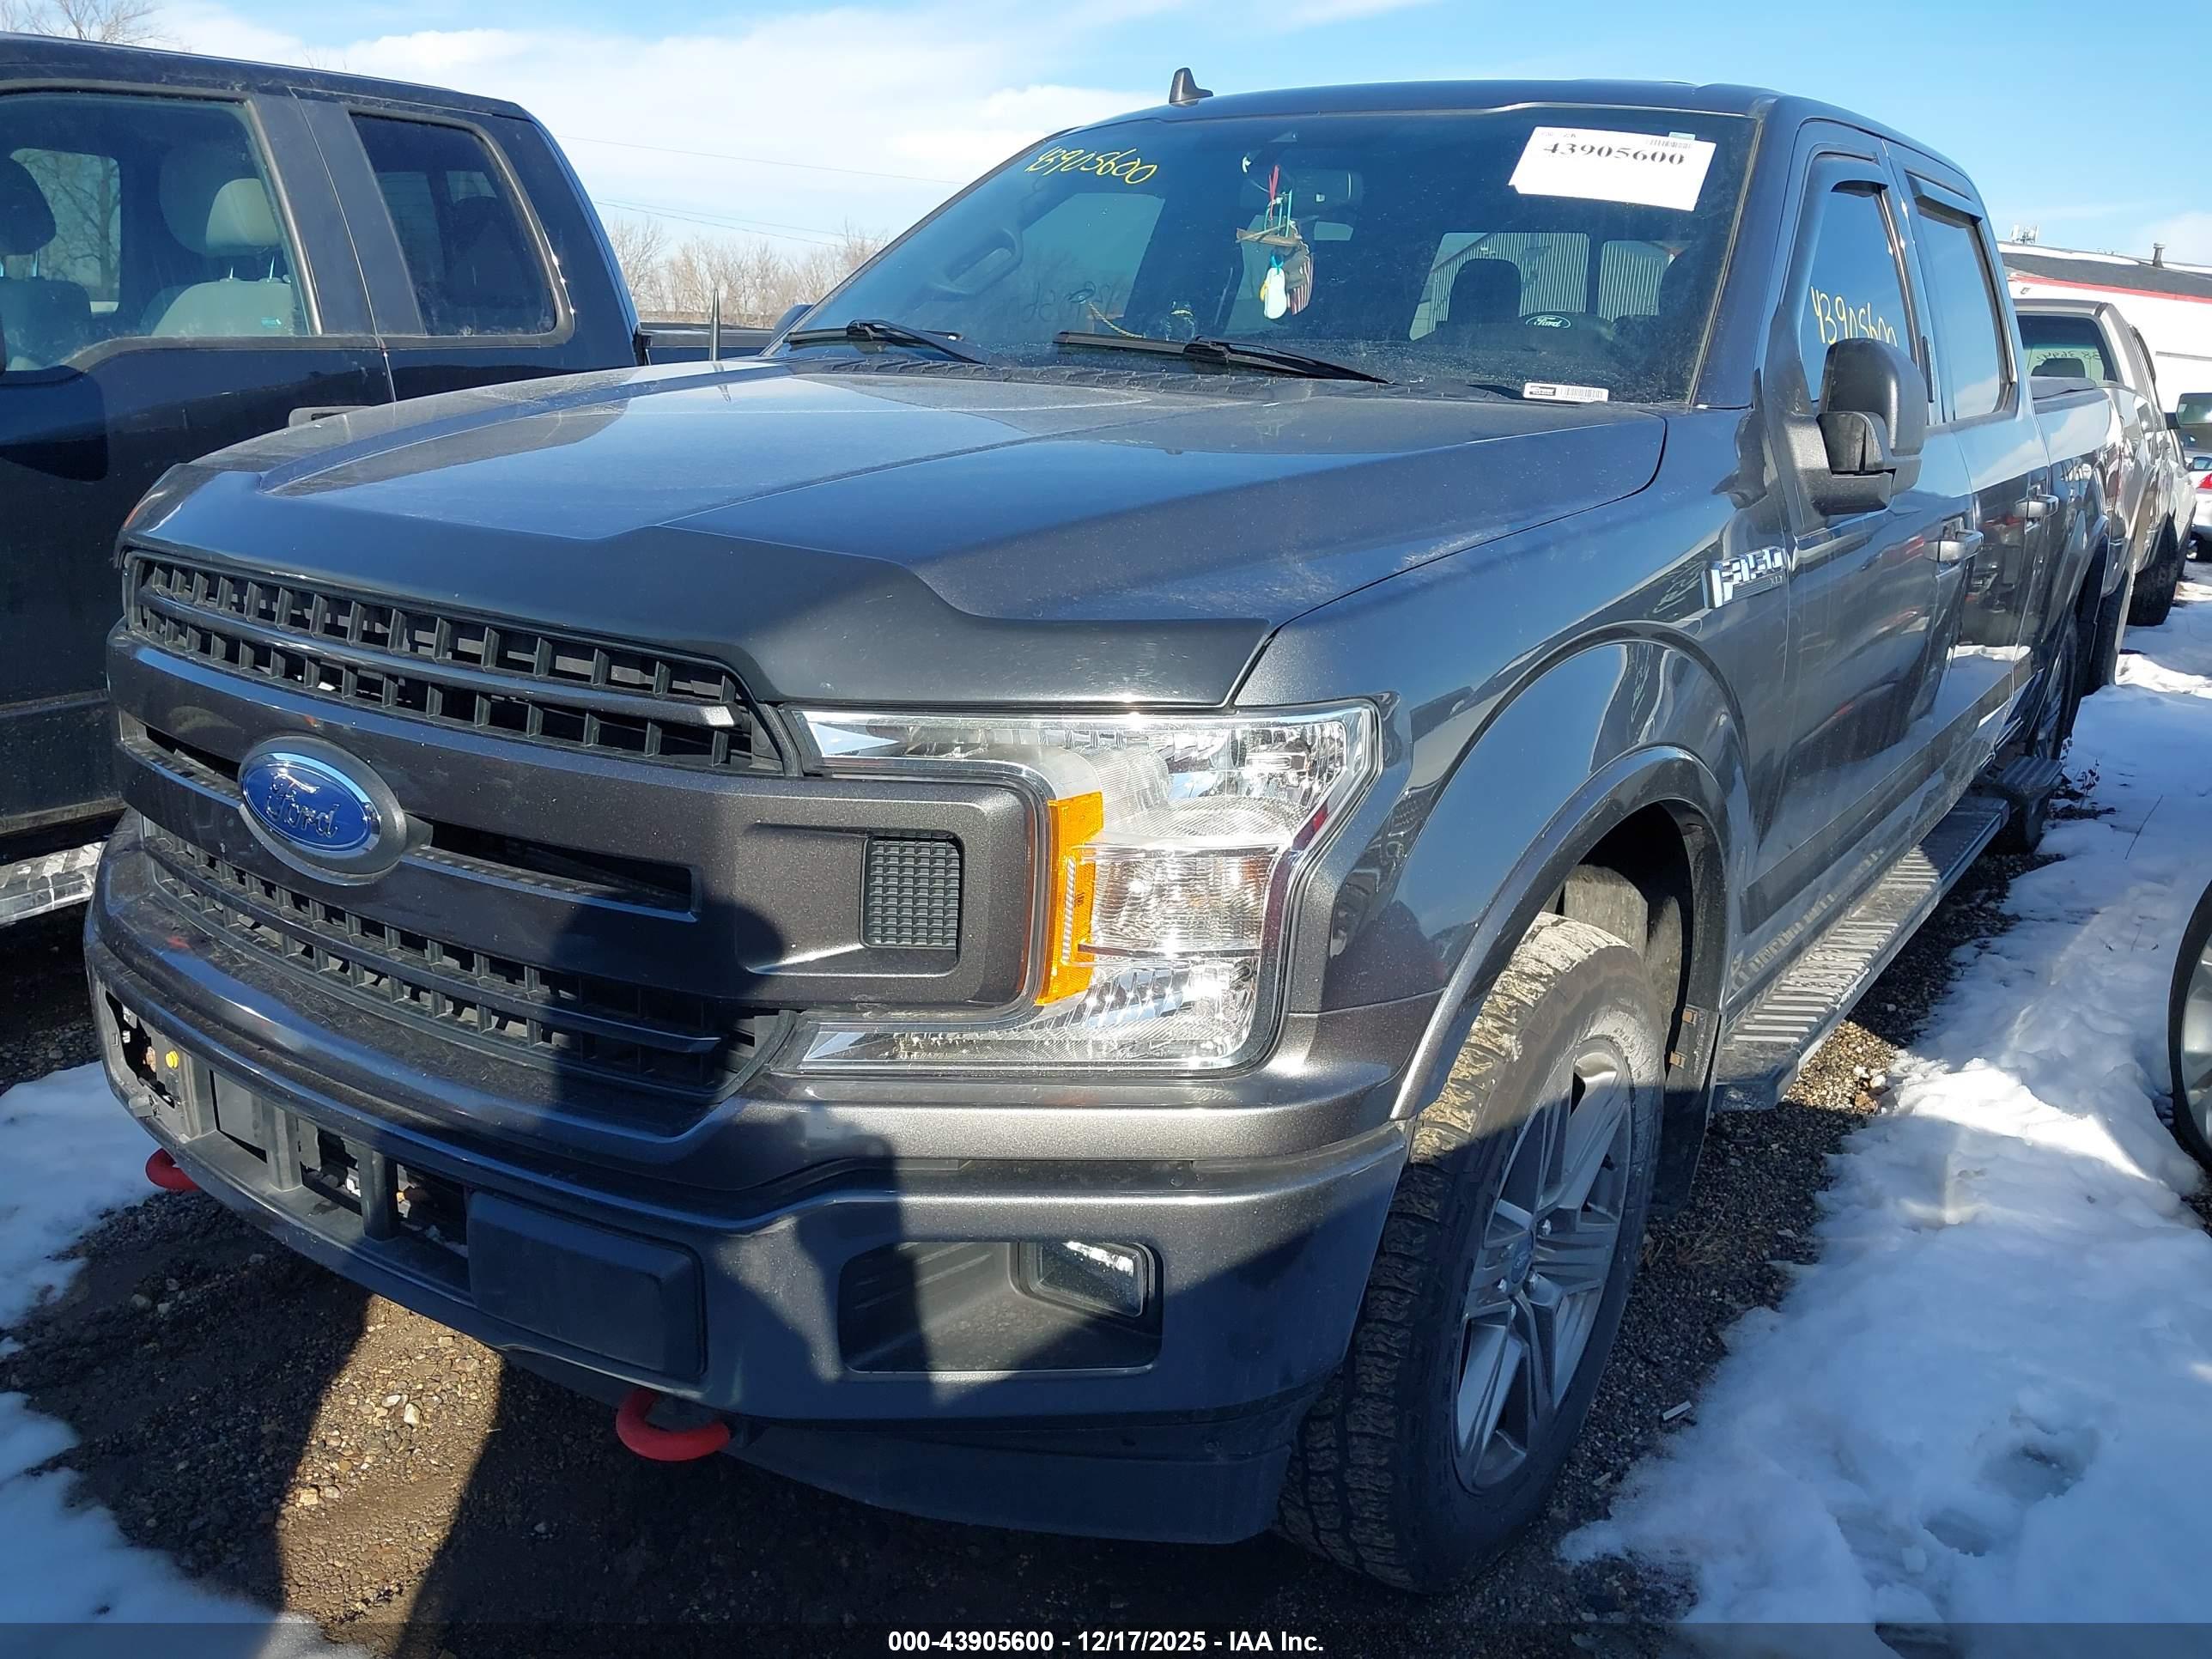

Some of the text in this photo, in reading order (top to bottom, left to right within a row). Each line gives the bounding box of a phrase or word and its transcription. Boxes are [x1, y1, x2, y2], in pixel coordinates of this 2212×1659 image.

[1543, 142, 1686, 165] 43905600
[1534, 316, 1563, 327] Ford
[265, 767, 341, 839] Ford
